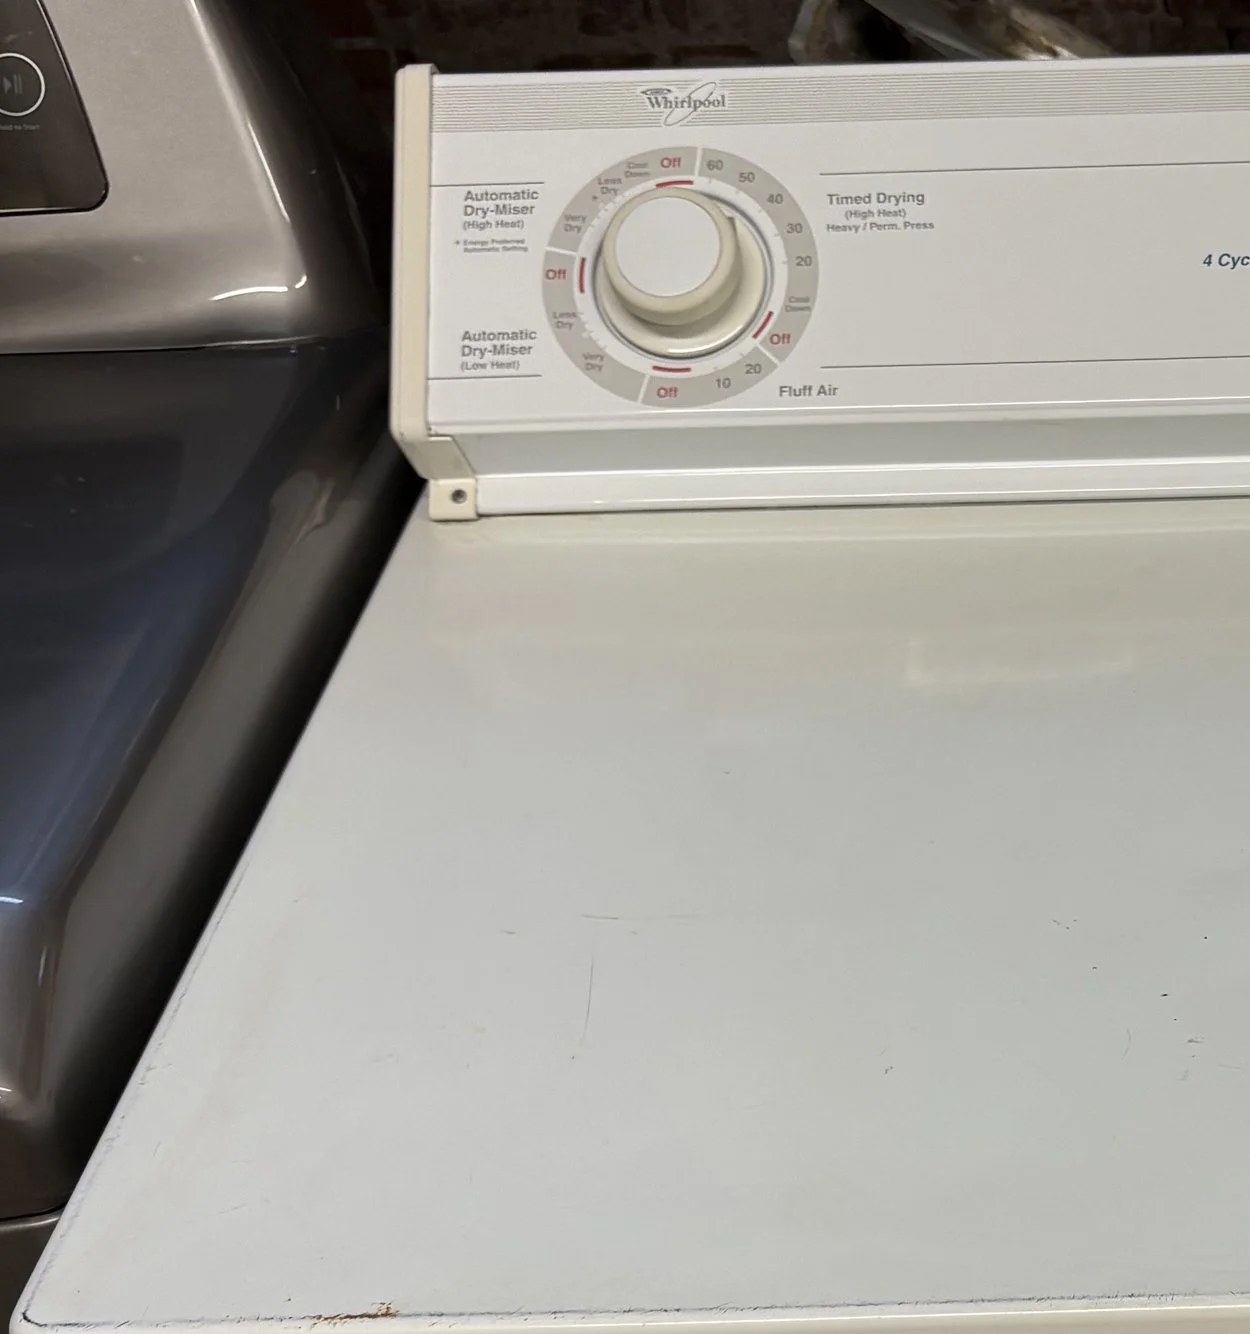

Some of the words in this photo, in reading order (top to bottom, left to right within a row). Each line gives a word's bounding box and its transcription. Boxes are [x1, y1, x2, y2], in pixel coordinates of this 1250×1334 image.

[647, 95, 726, 112] Whirlpool
[660, 157, 682, 169] Off
[707, 160, 724, 171] 60
[738, 172, 756, 183] 50
[464, 189, 540, 202] Automatic
[768, 194, 784, 205] 40
[826, 192, 872, 205] Timed
[876, 191, 926, 206] Drying
[463, 204, 536, 219] Dry-Miser
[845, 209, 875, 220] (High
[877, 208, 907, 218] Heat)
[463, 221, 493, 231] (High
[495, 219, 525, 230] Heat)
[786, 222, 804, 234] 30
[826, 223, 860, 234] Heavy
[869, 221, 902, 231] Perm.
[904, 220, 935, 230] Press
[795, 256, 813, 267] 20
[1202, 254, 1212, 267] 4
[545, 268, 568, 281] Off
[461, 329, 538, 342] Automatic
[769, 332, 792, 346] Off
[461, 344, 534, 359] Dry-Miser
[460, 361, 488, 372] (Low
[490, 359, 520, 370] Heat)
[745, 363, 762, 374] 20
[716, 378, 731, 389] 10
[656, 386, 678, 399] Off
[779, 384, 813, 398] Fluff
[816, 384, 839, 397] Air
